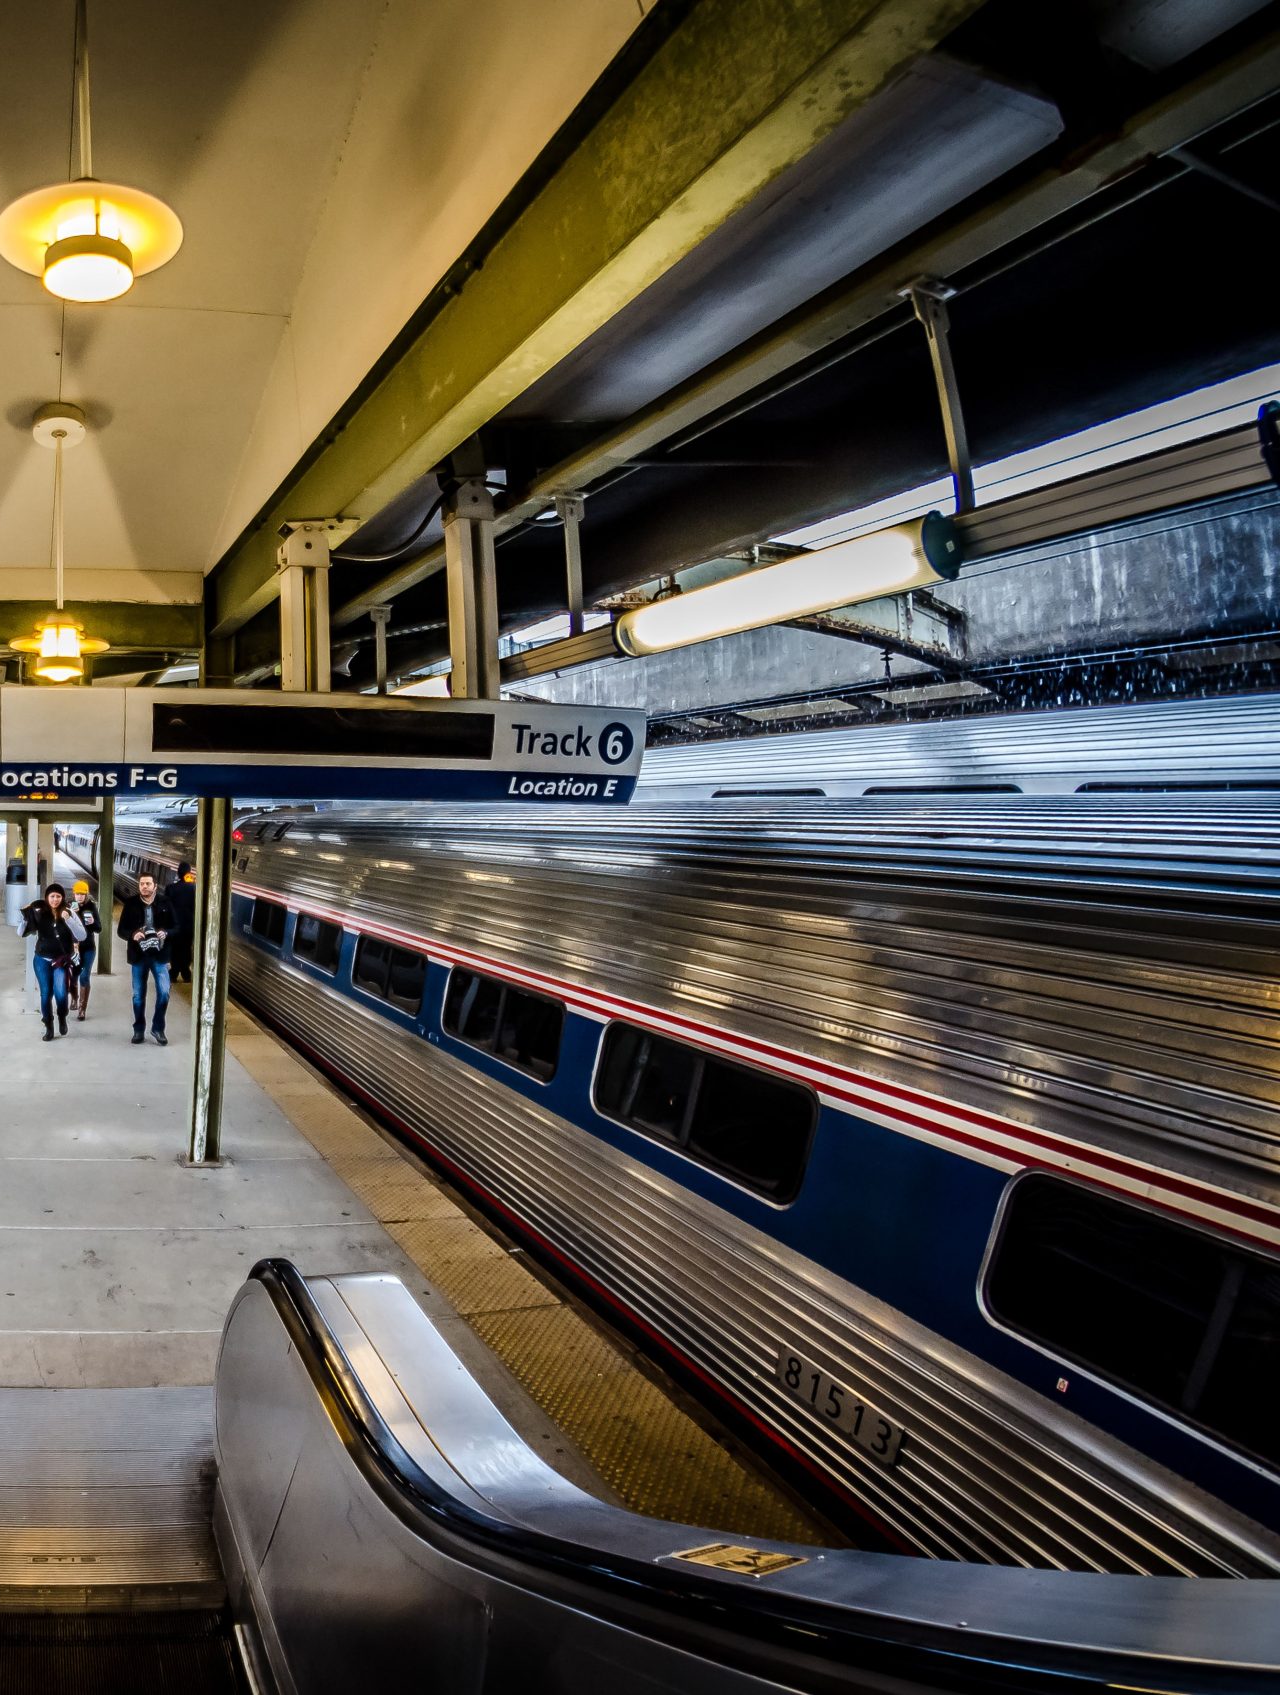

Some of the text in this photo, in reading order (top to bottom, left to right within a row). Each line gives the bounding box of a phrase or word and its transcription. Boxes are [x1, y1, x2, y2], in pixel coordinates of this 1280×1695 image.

[511, 724, 623, 760] Track 6
[129, 768, 178, 788] F-G
[508, 776, 618, 797] Location E
[784, 1356, 892, 1456] 81513
